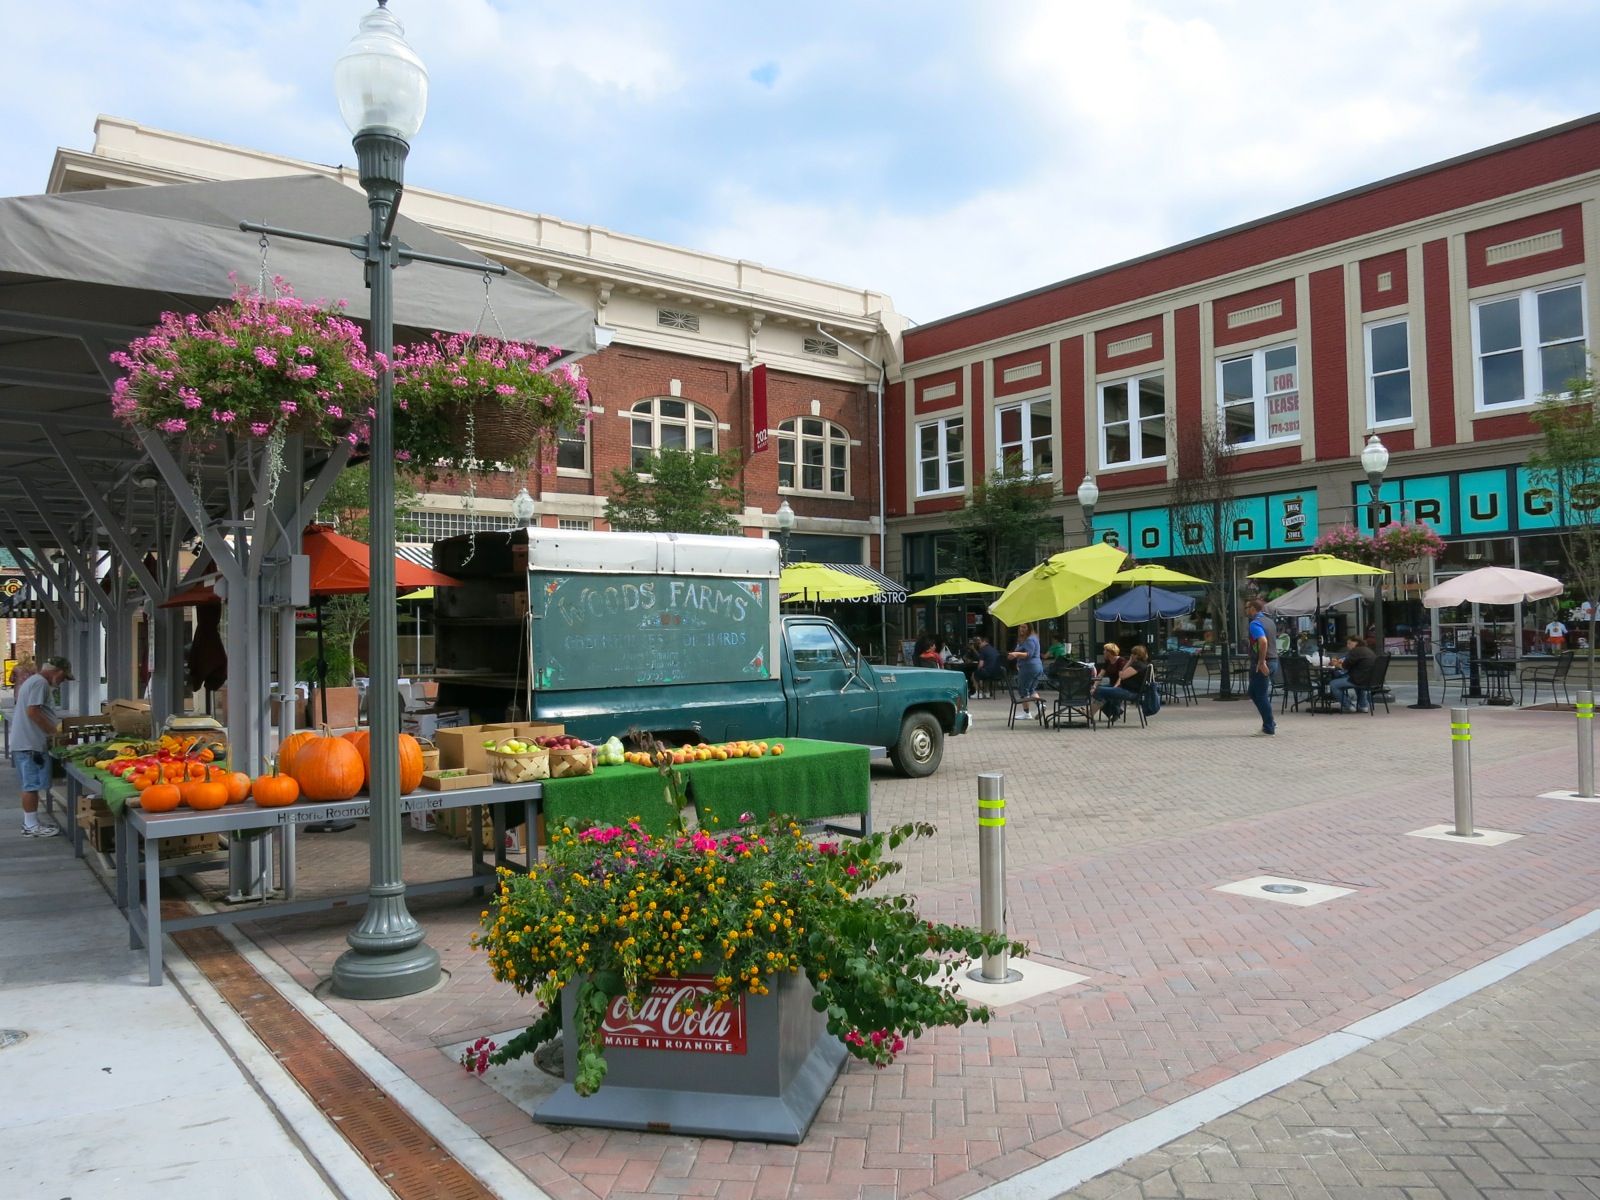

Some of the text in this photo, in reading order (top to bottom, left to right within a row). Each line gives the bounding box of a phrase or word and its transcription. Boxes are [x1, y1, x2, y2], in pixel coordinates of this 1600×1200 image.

[1273, 373, 1293, 391] FOR
[1269, 395, 1300, 415] LEASE
[755, 428, 768, 444] 202
[1102, 518, 1254, 549] SODA
[558, 581, 748, 626] WOODS FARMS
[872, 591, 908, 604] BISTRO
[683, 632, 747, 647] OHARDS
[277, 798, 443, 823] Historic Roanok Market
[601, 985, 731, 1037] oca-Cola
[605, 1036, 733, 1052] MADE IN ROANOKE
